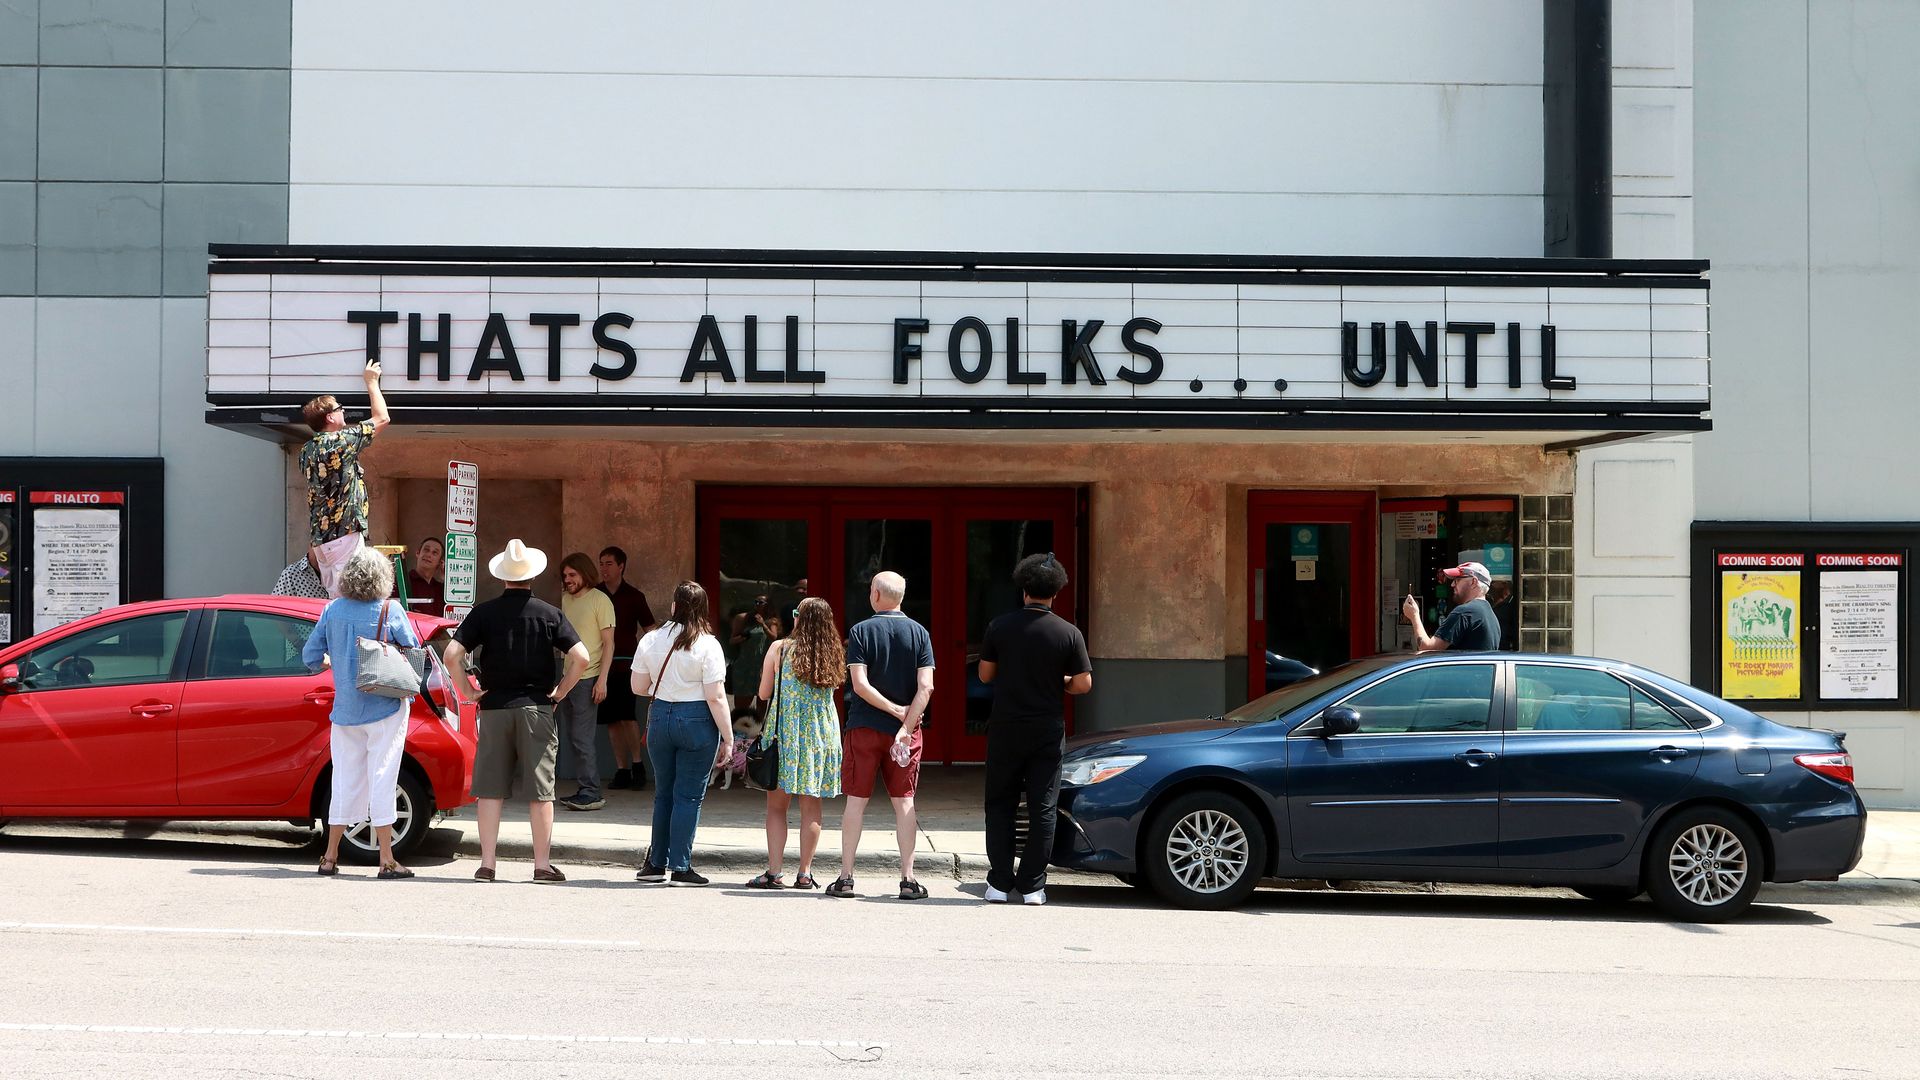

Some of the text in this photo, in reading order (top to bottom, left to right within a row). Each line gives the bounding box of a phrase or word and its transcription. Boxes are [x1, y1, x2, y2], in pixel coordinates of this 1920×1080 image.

[347, 311, 638, 382] THATS
[680, 314, 826, 384] ALL
[1342, 320, 1577, 388] UNTIL
[450, 467, 475, 481] NO PARKING
[54, 493, 100, 503] RIALTO
[448, 538, 454, 555] 2
[456, 548, 474, 558] PARKING
[1722, 556, 1801, 566] COMING SOON
[1819, 556, 1898, 566] COMING SOON
[450, 576, 472, 585] MON-SAT
[1744, 662, 1766, 670] ROCKY
